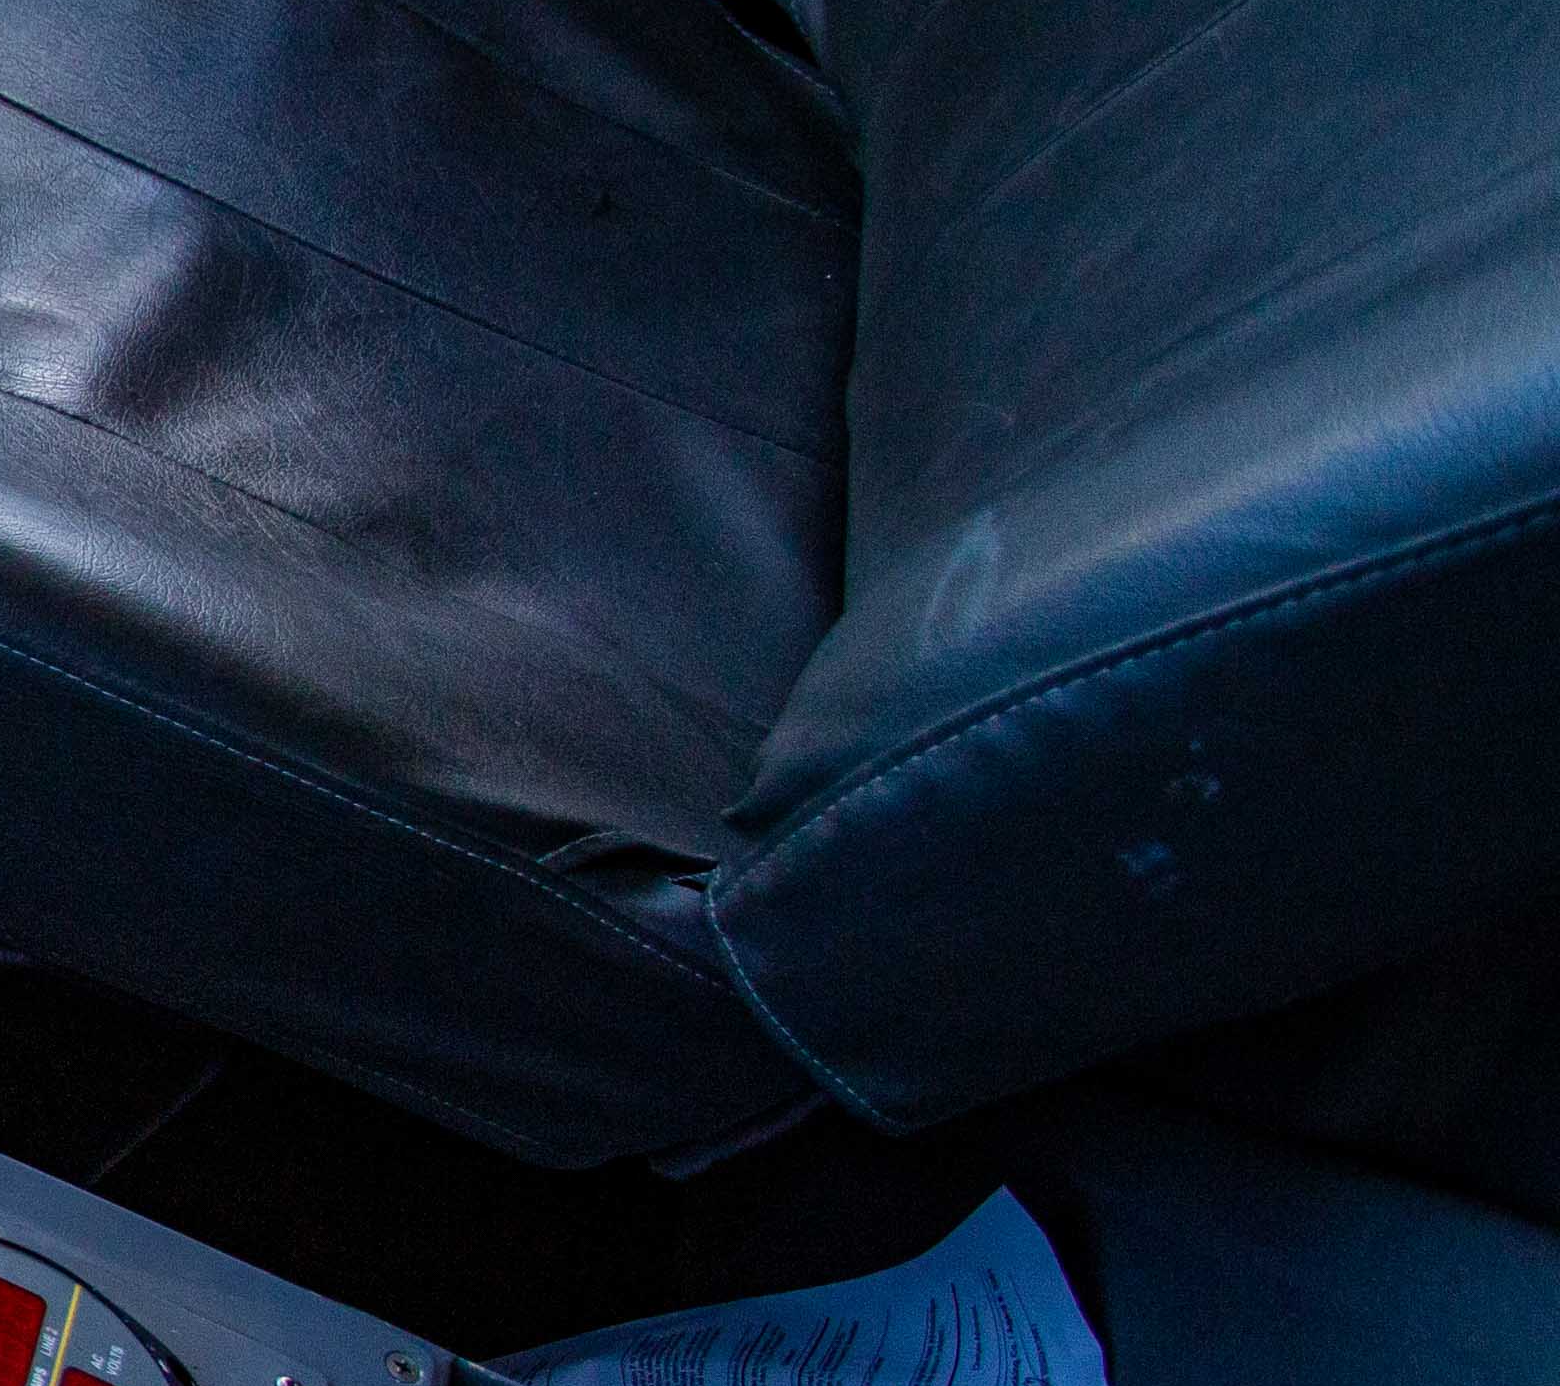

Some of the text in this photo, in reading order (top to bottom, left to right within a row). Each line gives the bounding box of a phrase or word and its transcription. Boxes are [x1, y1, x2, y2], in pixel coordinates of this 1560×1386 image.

[39, 1334, 58, 1358] LINE
[90, 1352, 105, 1371] AC
[106, 1345, 125, 1377] VOLTS
